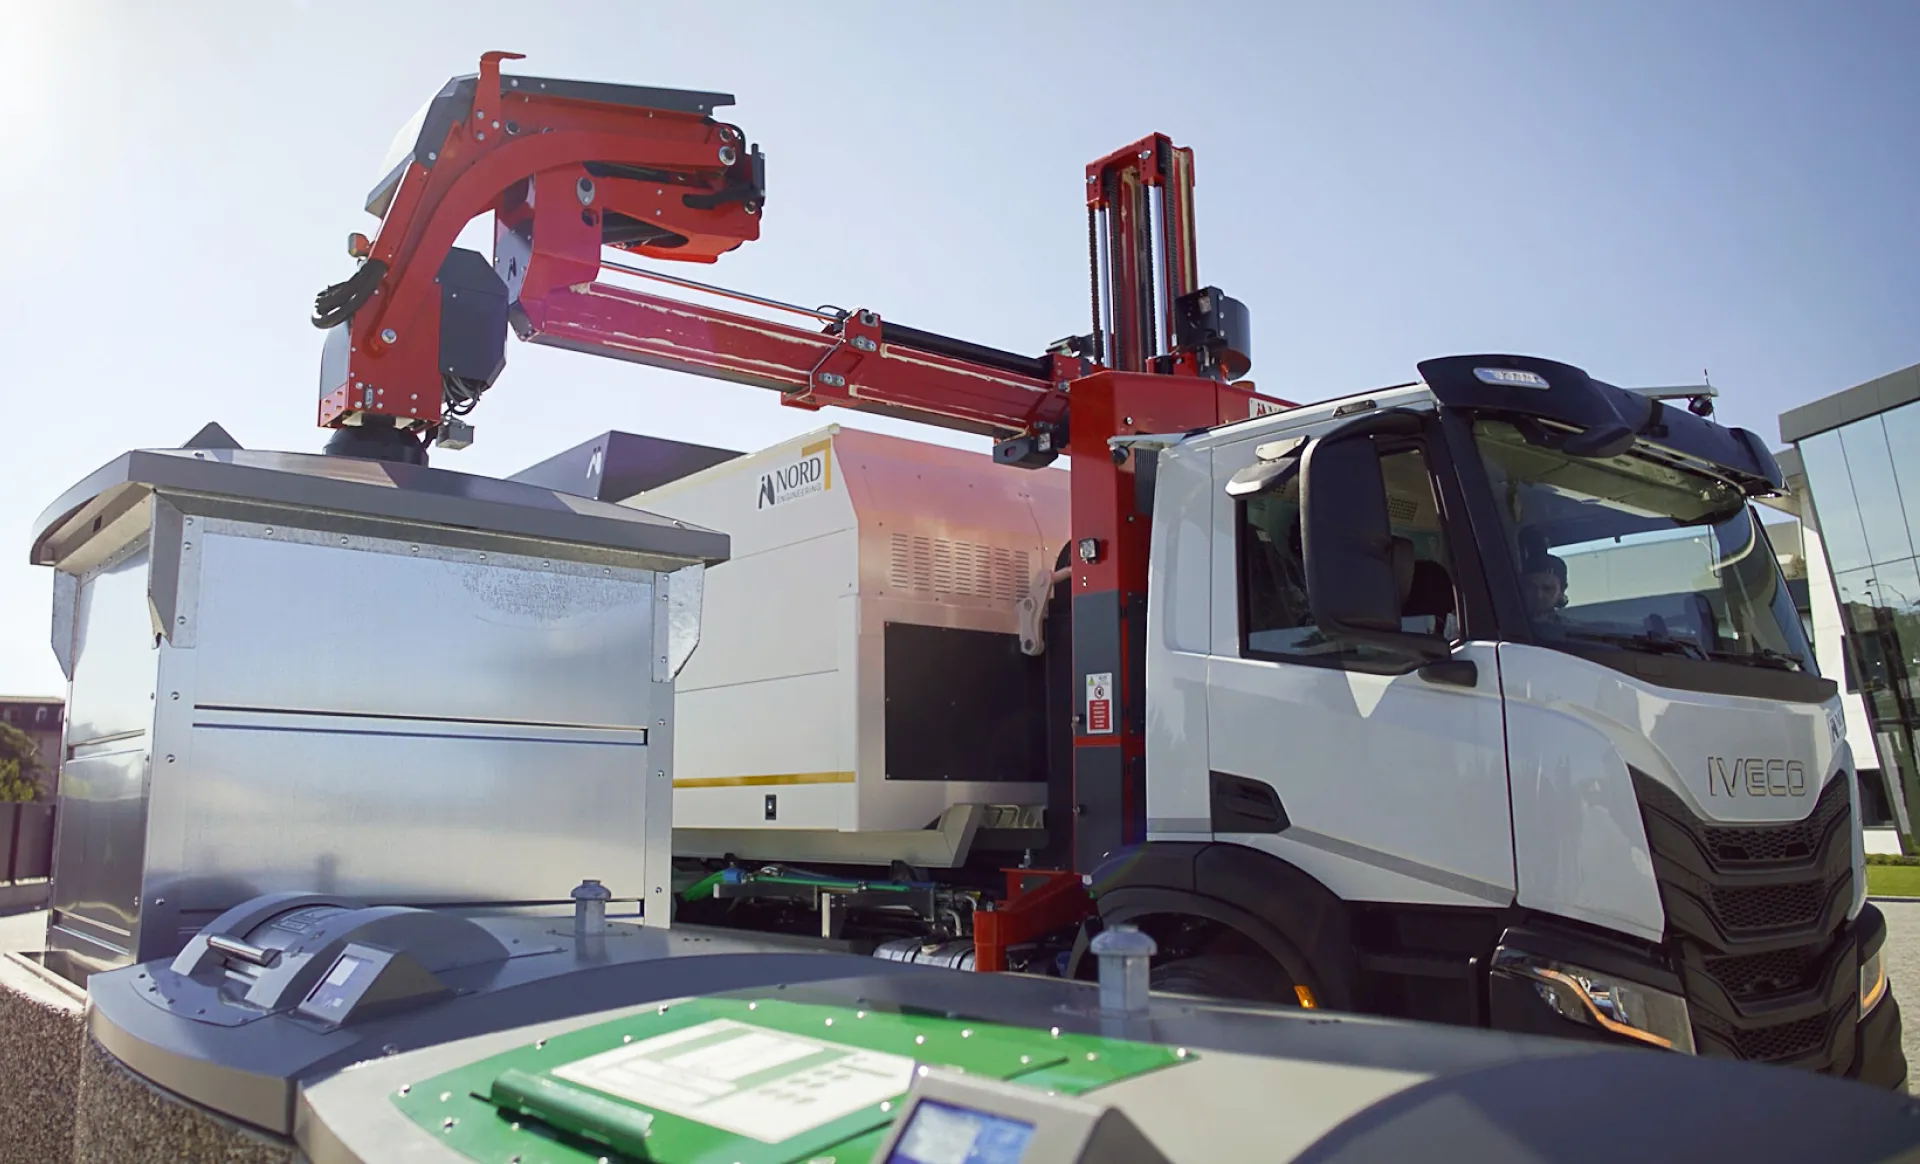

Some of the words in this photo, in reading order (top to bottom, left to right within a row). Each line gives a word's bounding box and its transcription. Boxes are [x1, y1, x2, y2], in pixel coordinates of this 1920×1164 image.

[776, 457, 821, 492] NORD
[777, 482, 821, 504] ENGINEERING
[1707, 756, 1806, 798] IVECO
